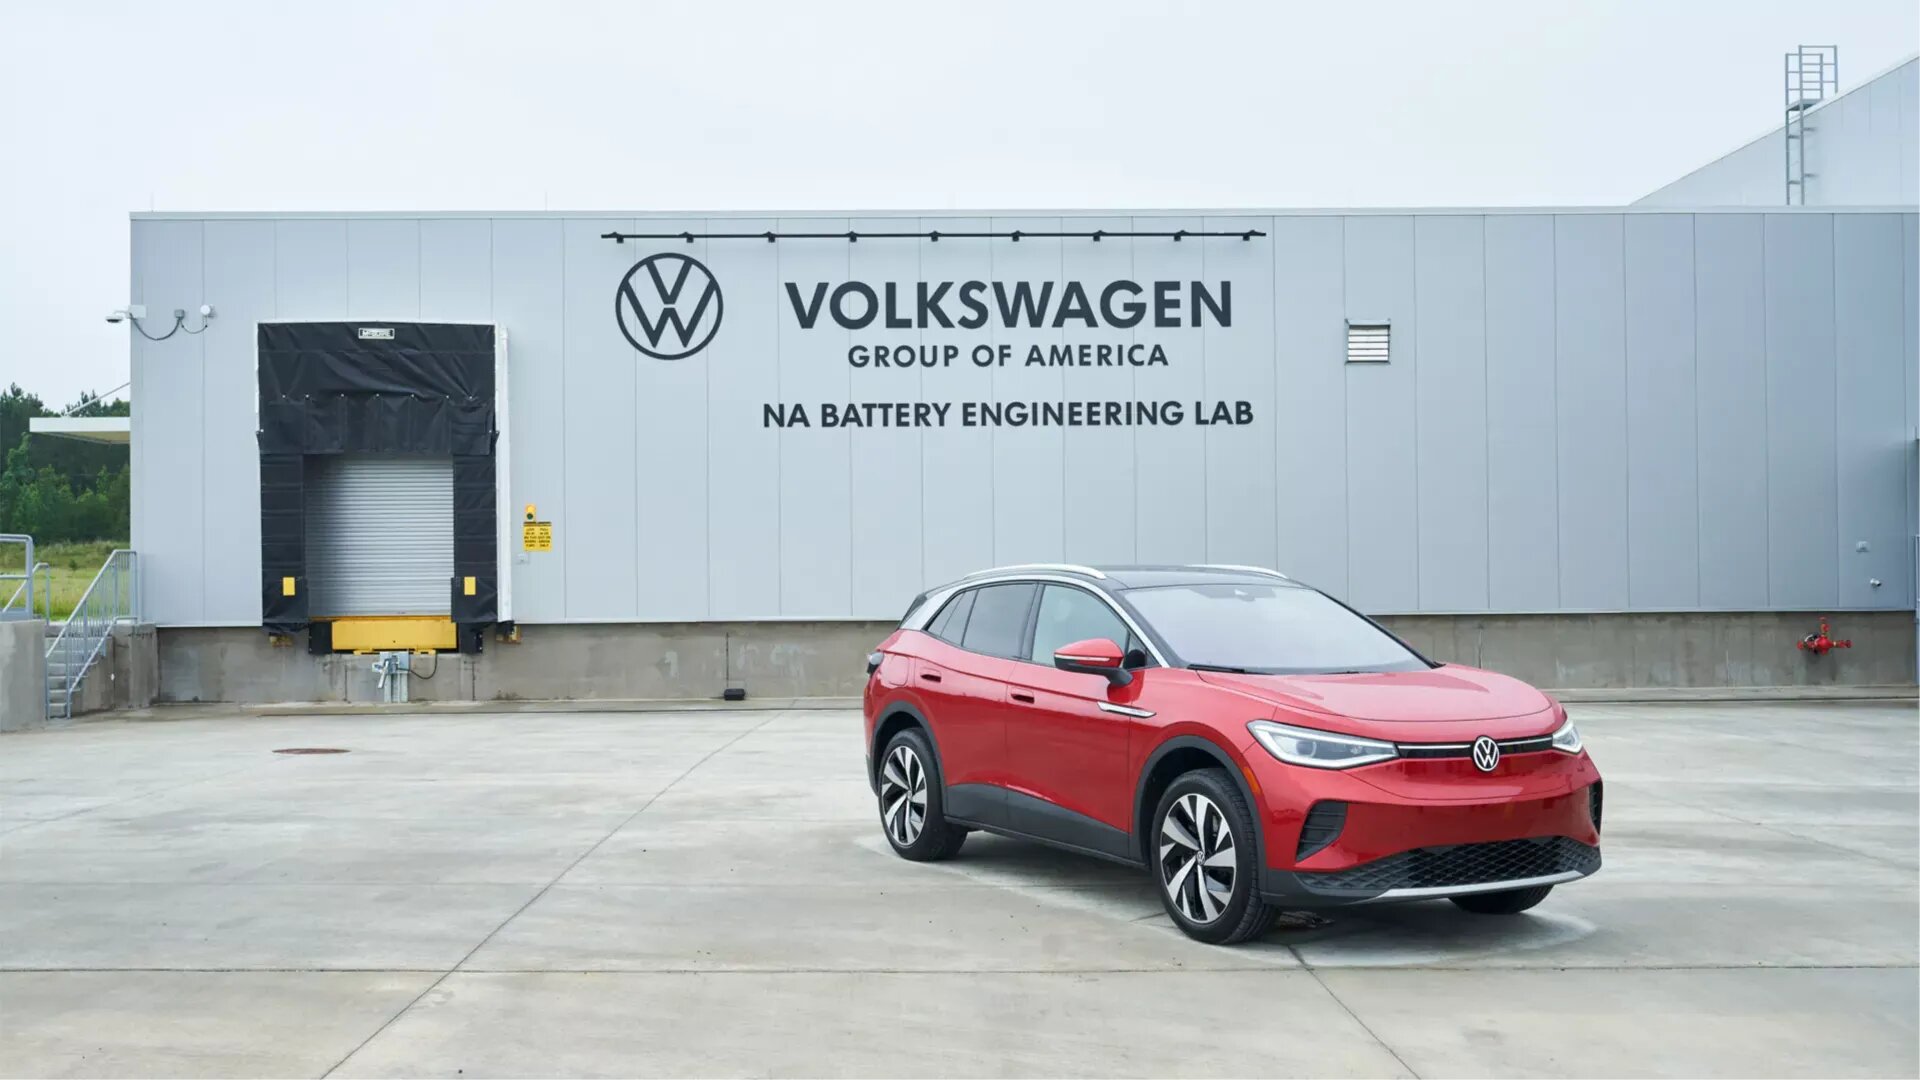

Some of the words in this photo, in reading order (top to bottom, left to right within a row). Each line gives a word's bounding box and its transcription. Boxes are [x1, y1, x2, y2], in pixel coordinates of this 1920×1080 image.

[615, 252, 724, 361] VW
[784, 279, 1232, 330] VOLKSWAGEN
[848, 344, 959, 368] GROUP
[971, 344, 1012, 368] OF
[1024, 343, 1169, 367] AMERICA
[763, 403, 811, 428] NA
[821, 402, 952, 428] BATTERY
[962, 400, 1185, 427] ENGINEERING
[1195, 400, 1254, 426] LAB
[1473, 737, 1500, 772] VW
